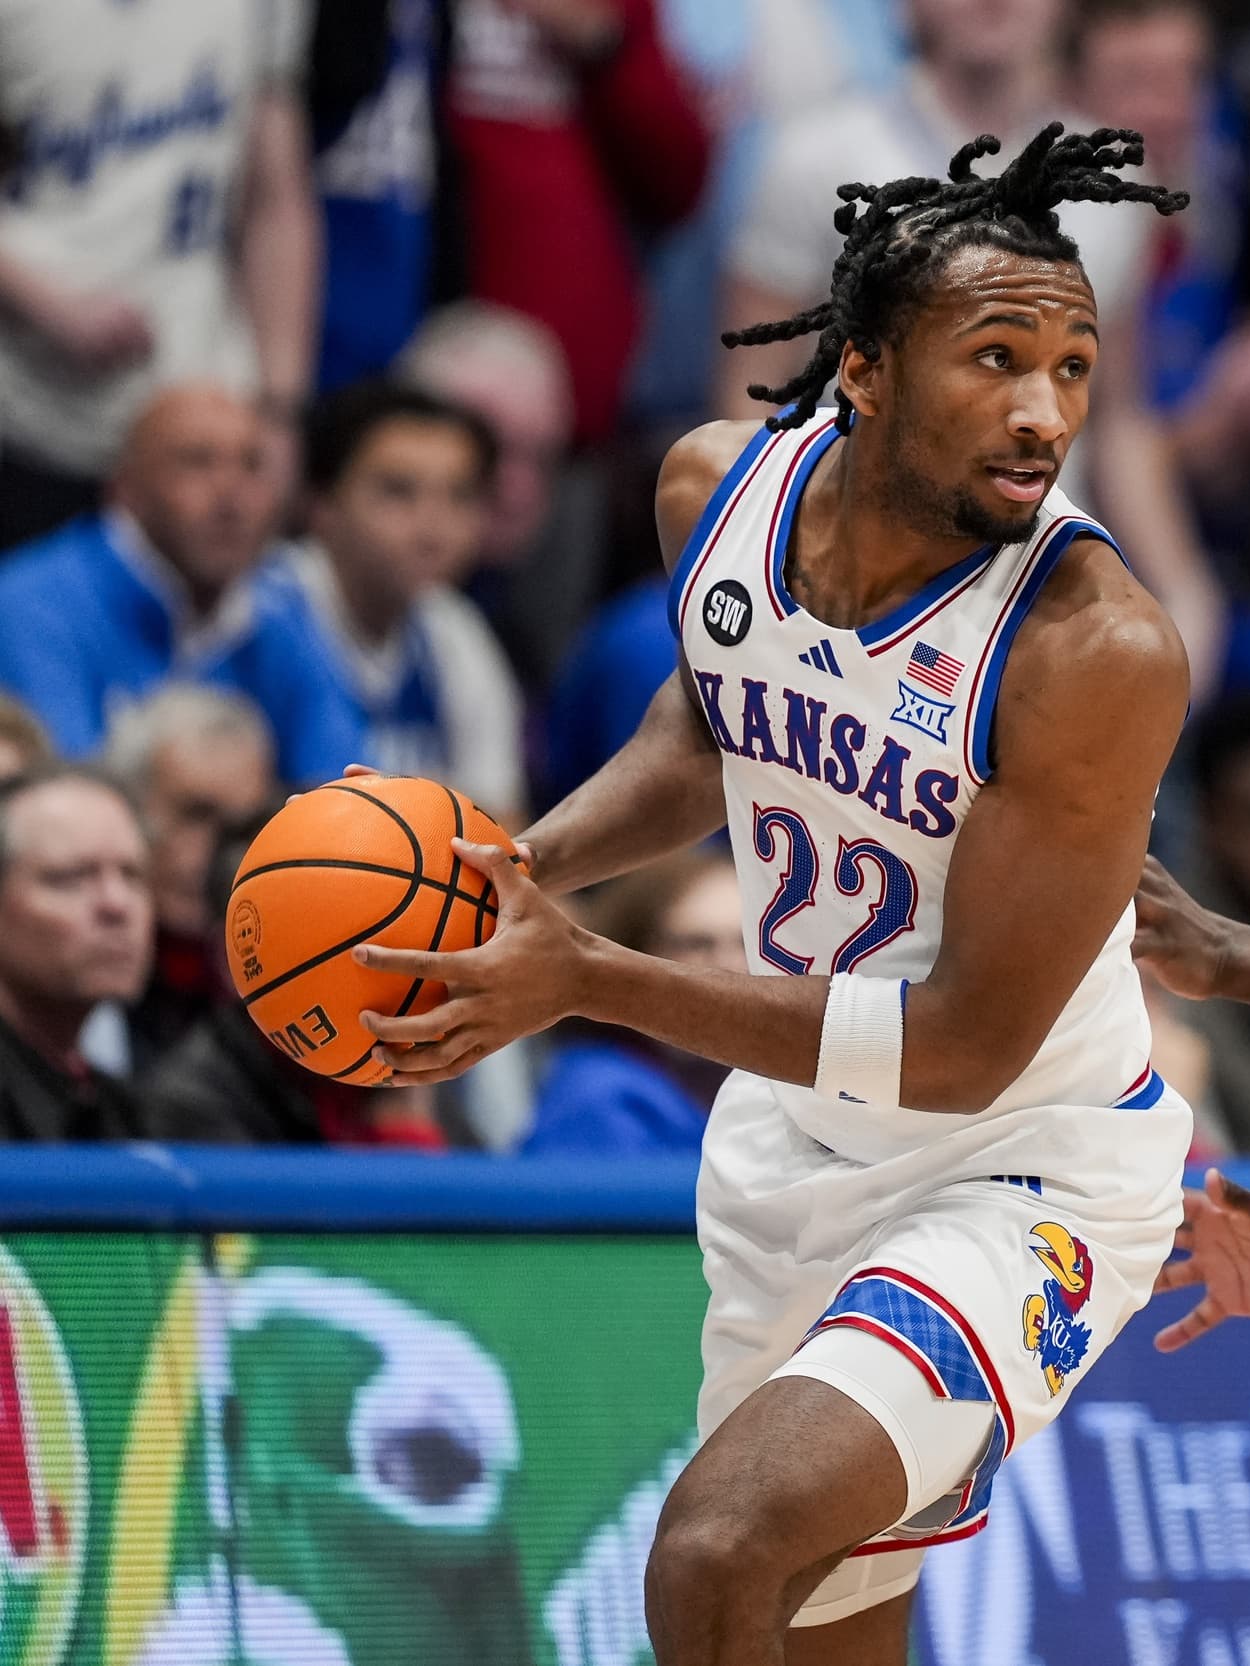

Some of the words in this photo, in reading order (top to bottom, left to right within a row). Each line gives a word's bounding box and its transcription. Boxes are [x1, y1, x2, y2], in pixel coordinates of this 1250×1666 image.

[706, 588, 748, 638] SW
[694, 669, 959, 838] KANSAS
[753, 801, 918, 976] 22
